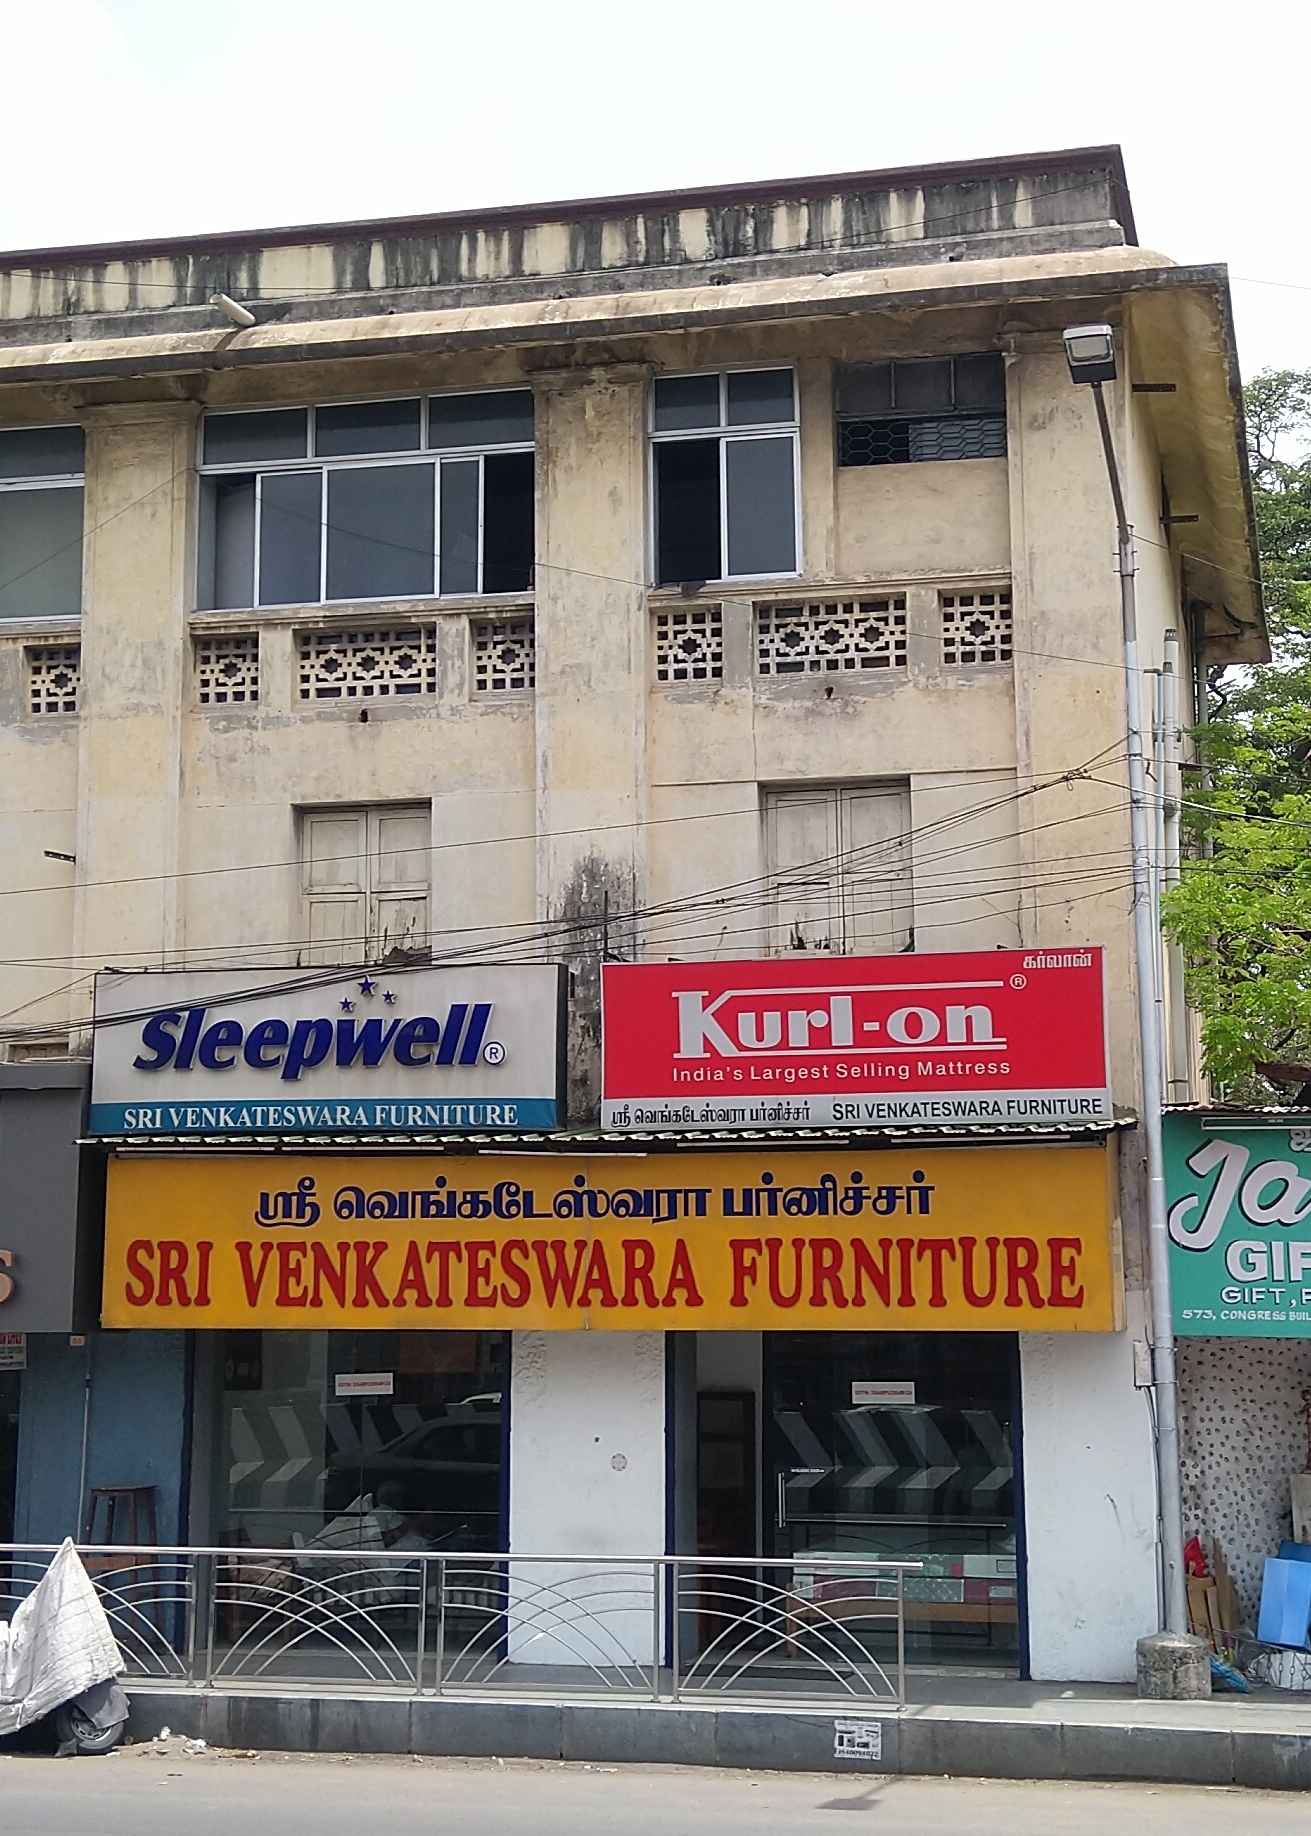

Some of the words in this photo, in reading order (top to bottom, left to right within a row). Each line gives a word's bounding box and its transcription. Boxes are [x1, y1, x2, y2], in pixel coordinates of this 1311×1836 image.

[1023, 949, 1093, 970] கர்லான்
[132, 1002, 492, 1081] Sleepwell
[750, 1066, 828, 1084] Largest
[836, 1063, 910, 1080] Selling
[917, 1061, 1010, 1077] Mattress
[123, 1107, 165, 1129] SRI
[168, 1106, 369, 1129] VENKATESWARA
[374, 1105, 518, 1127] FURNITURE
[832, 1102, 863, 1120] SRI
[865, 1100, 1001, 1120] VENKATESWARA
[1006, 1098, 1103, 1116] FURNITURE
[125, 1239, 214, 1307] SRI
[234, 1238, 704, 1309] VENKATESWARA
[728, 1236, 1086, 1309] FURNITURE
[1181, 1309, 1217, 1321] 573,
[1220, 1310, 1287, 1322] CONGRESS
